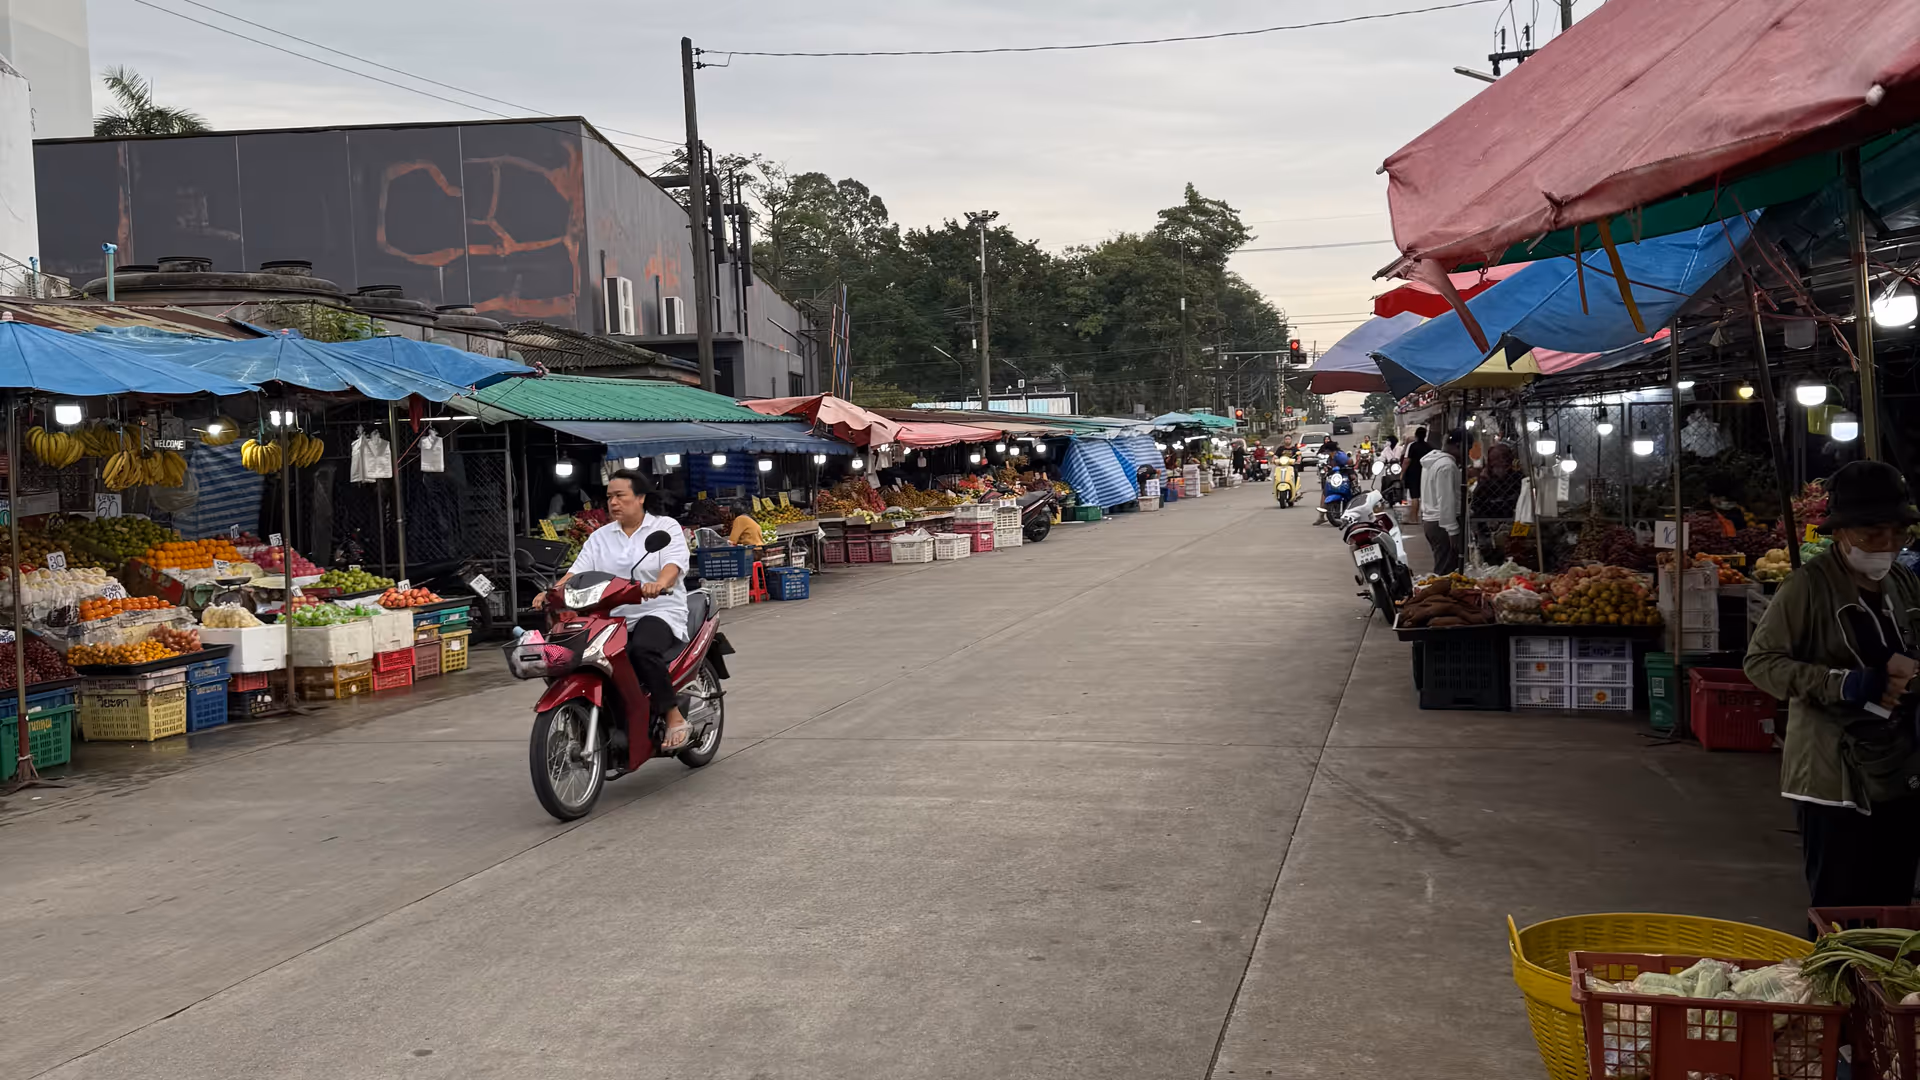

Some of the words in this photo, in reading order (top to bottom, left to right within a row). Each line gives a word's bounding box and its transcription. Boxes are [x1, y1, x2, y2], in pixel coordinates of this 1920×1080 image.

[154, 440, 185, 450] WELCOME
[97, 500, 119, 518] 60
[49, 554, 65, 570] 30
